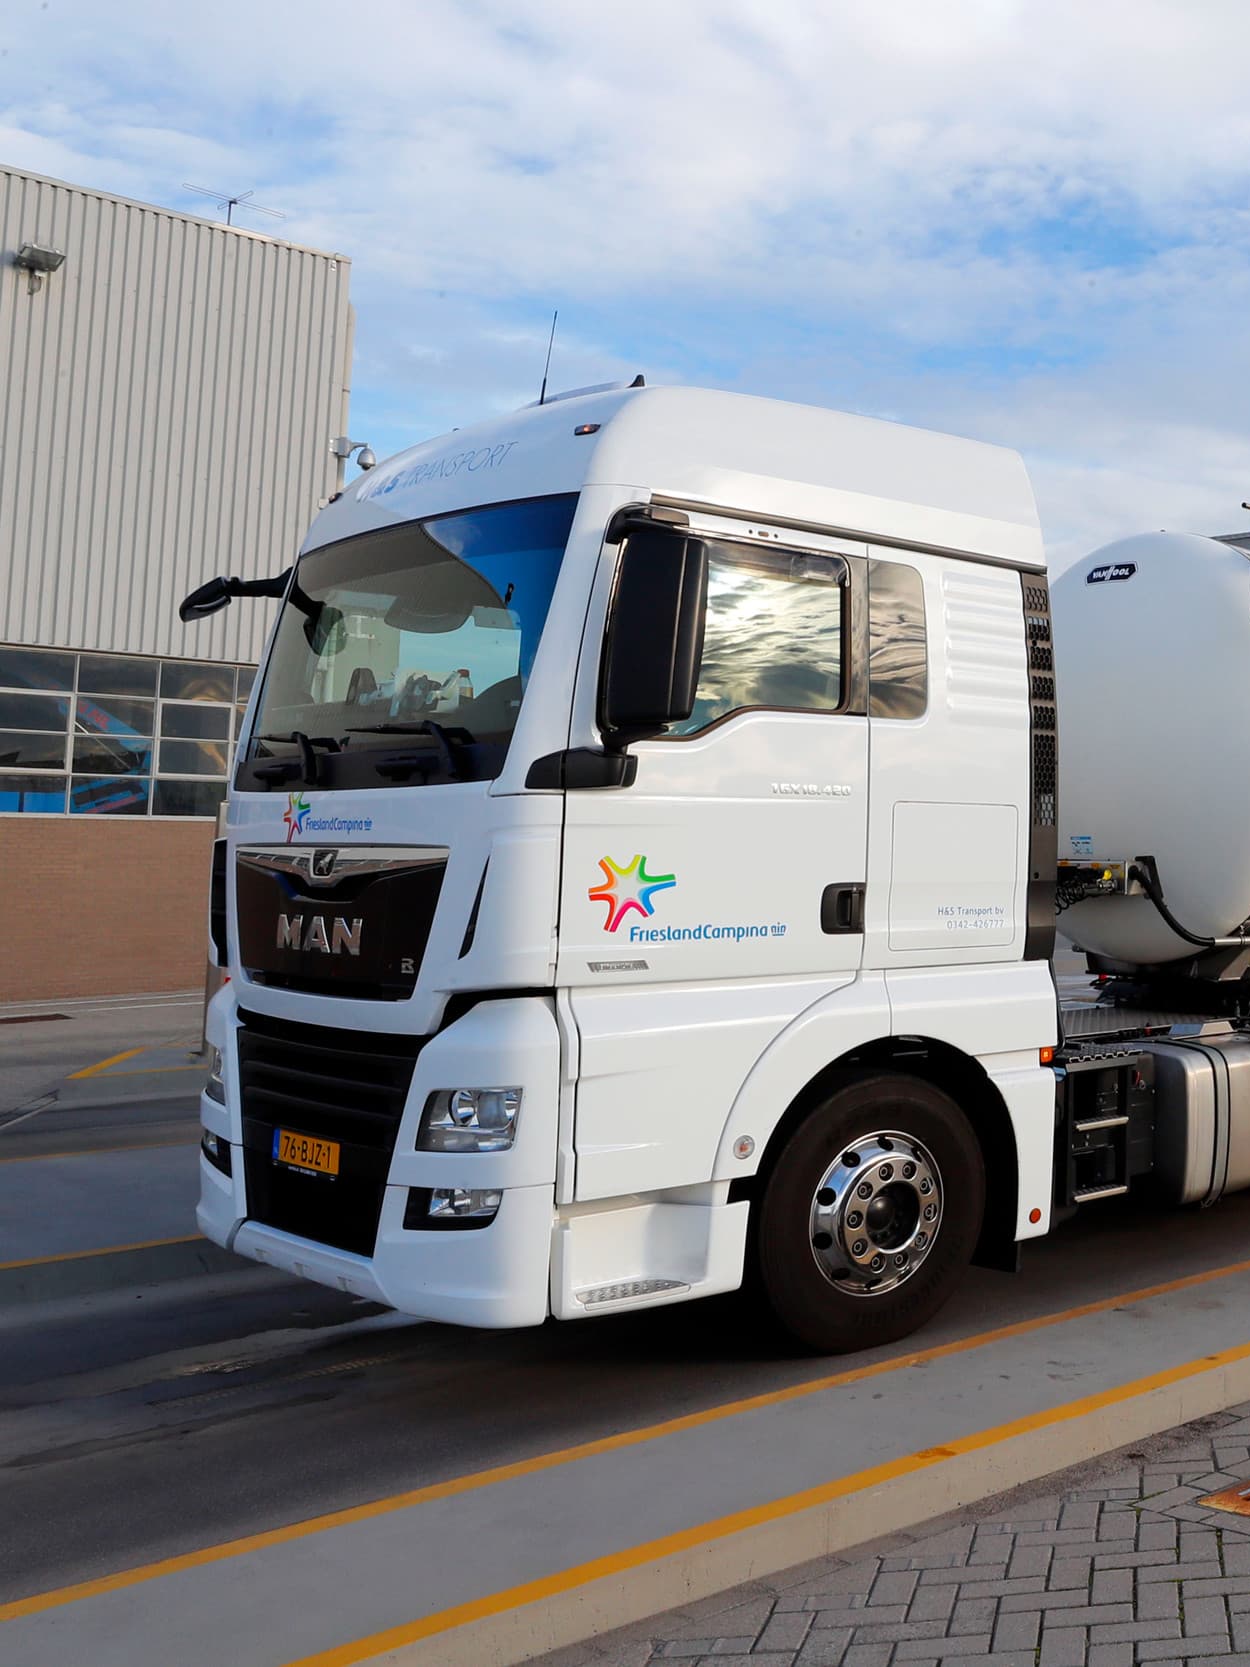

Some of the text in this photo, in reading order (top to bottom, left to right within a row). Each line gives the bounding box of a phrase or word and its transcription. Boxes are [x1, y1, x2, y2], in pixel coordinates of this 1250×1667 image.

[402, 441, 519, 489] TRANSPORT
[305, 817, 364, 833] FrieslandCampina
[937, 906, 1004, 917] H&S Transport bv
[276, 913, 363, 956] MAN
[629, 924, 768, 942] FrieslandCampina
[283, 1135, 331, 1169] 76-BJZ-1
